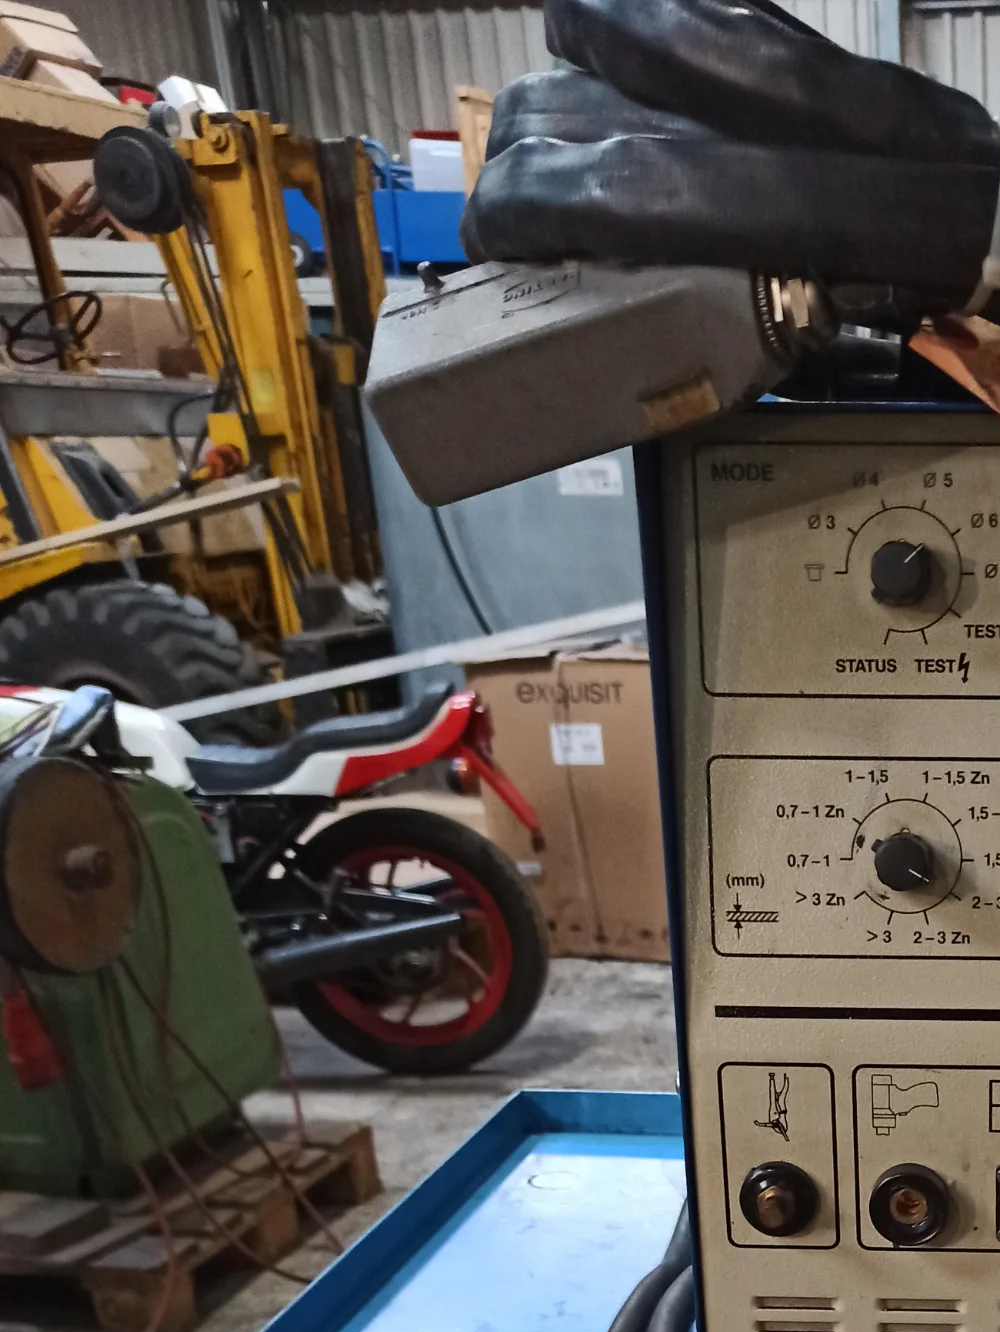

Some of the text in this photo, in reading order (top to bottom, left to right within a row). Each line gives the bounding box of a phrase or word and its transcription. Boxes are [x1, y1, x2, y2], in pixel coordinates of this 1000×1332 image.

[711, 463, 773, 482] MODE
[835, 658, 897, 673] STATUS
[915, 659, 956, 673] TEST
[970, 771, 990, 785] Zn
[825, 805, 845, 819] Zn
[725, 873, 765, 888] (mm)
[825, 892, 845, 907] Zn
[951, 931, 971, 945] Zn
